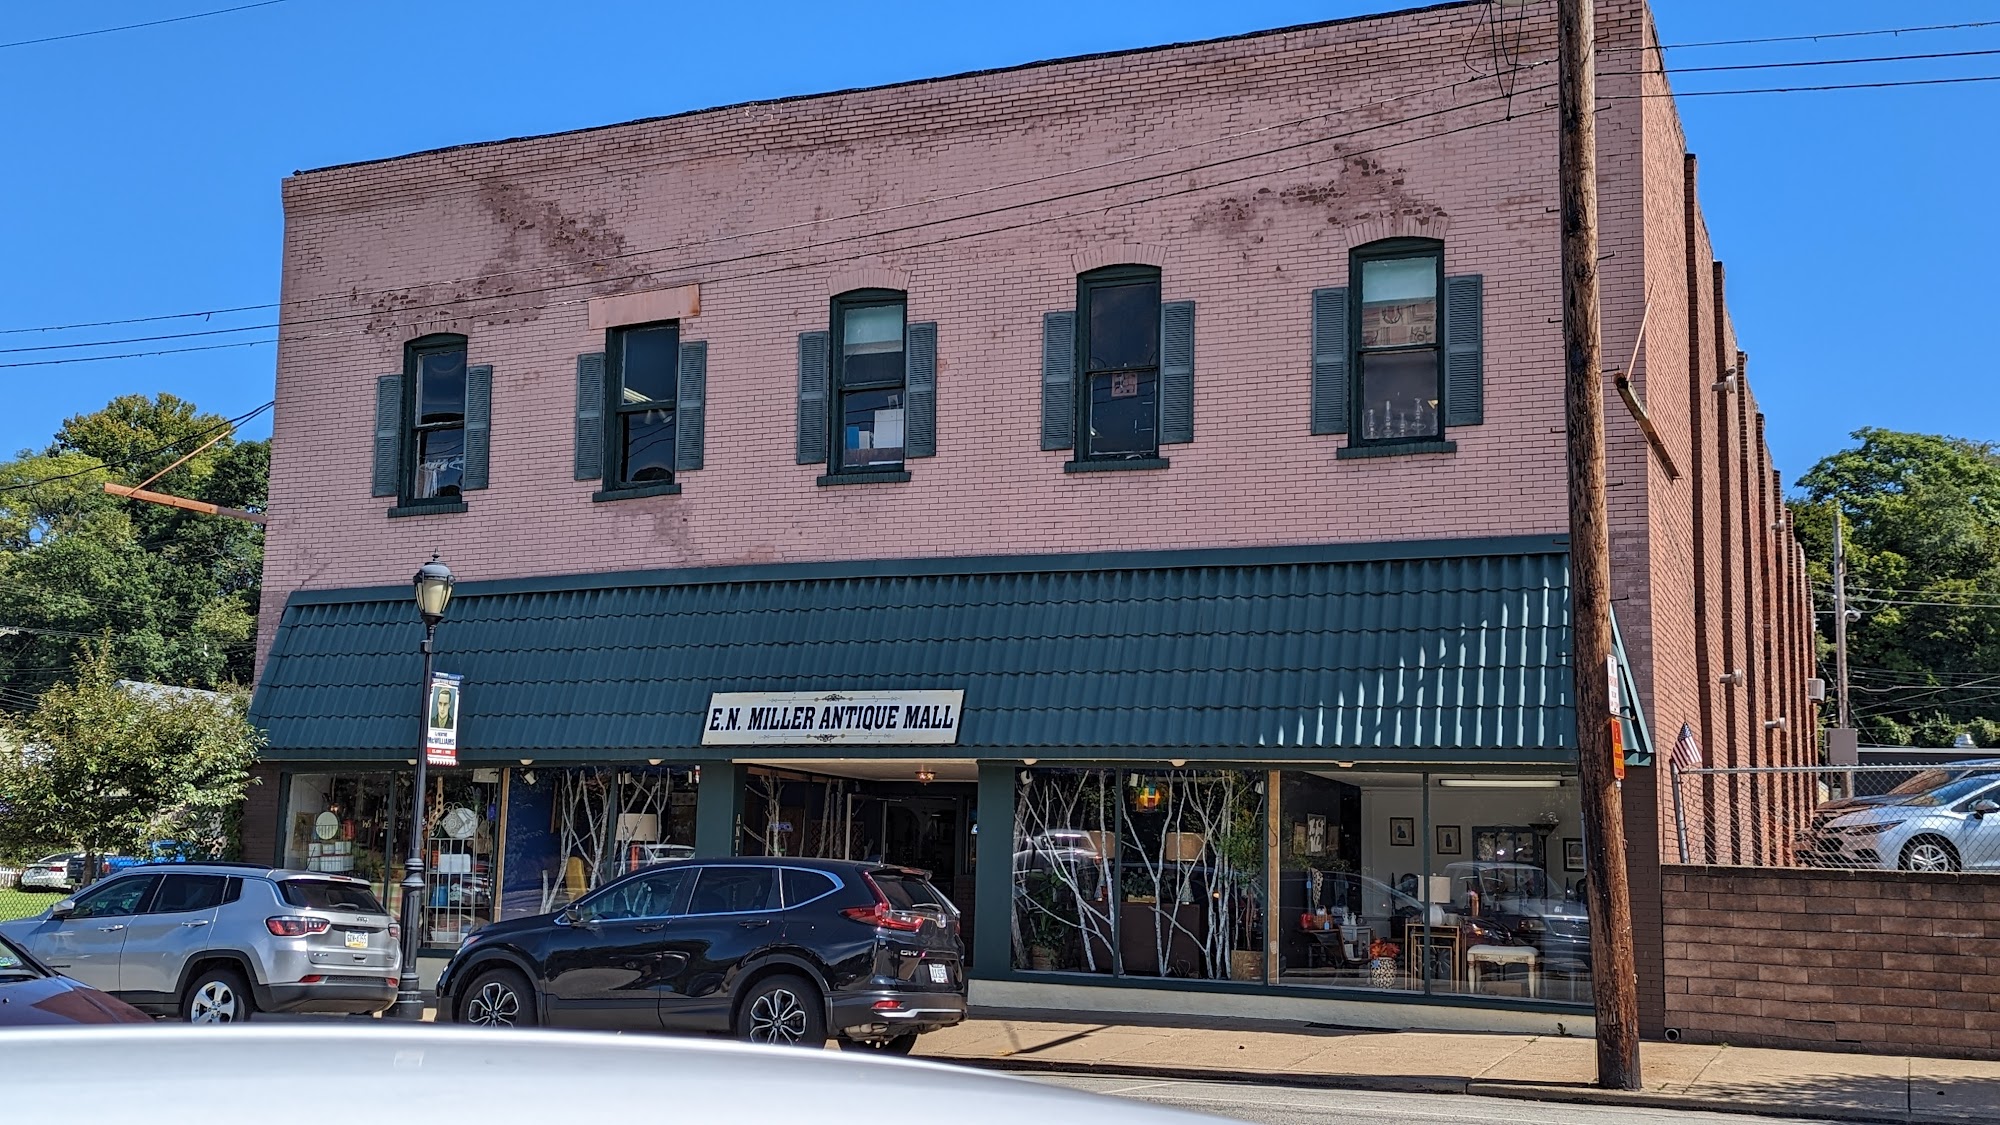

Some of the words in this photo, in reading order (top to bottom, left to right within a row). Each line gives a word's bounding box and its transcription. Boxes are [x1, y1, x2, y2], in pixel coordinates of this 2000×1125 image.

[708, 707, 741, 731] E.N.
[747, 706, 816, 730] MILLER
[818, 705, 900, 731] ANTIQUE
[902, 705, 954, 729] MALL
